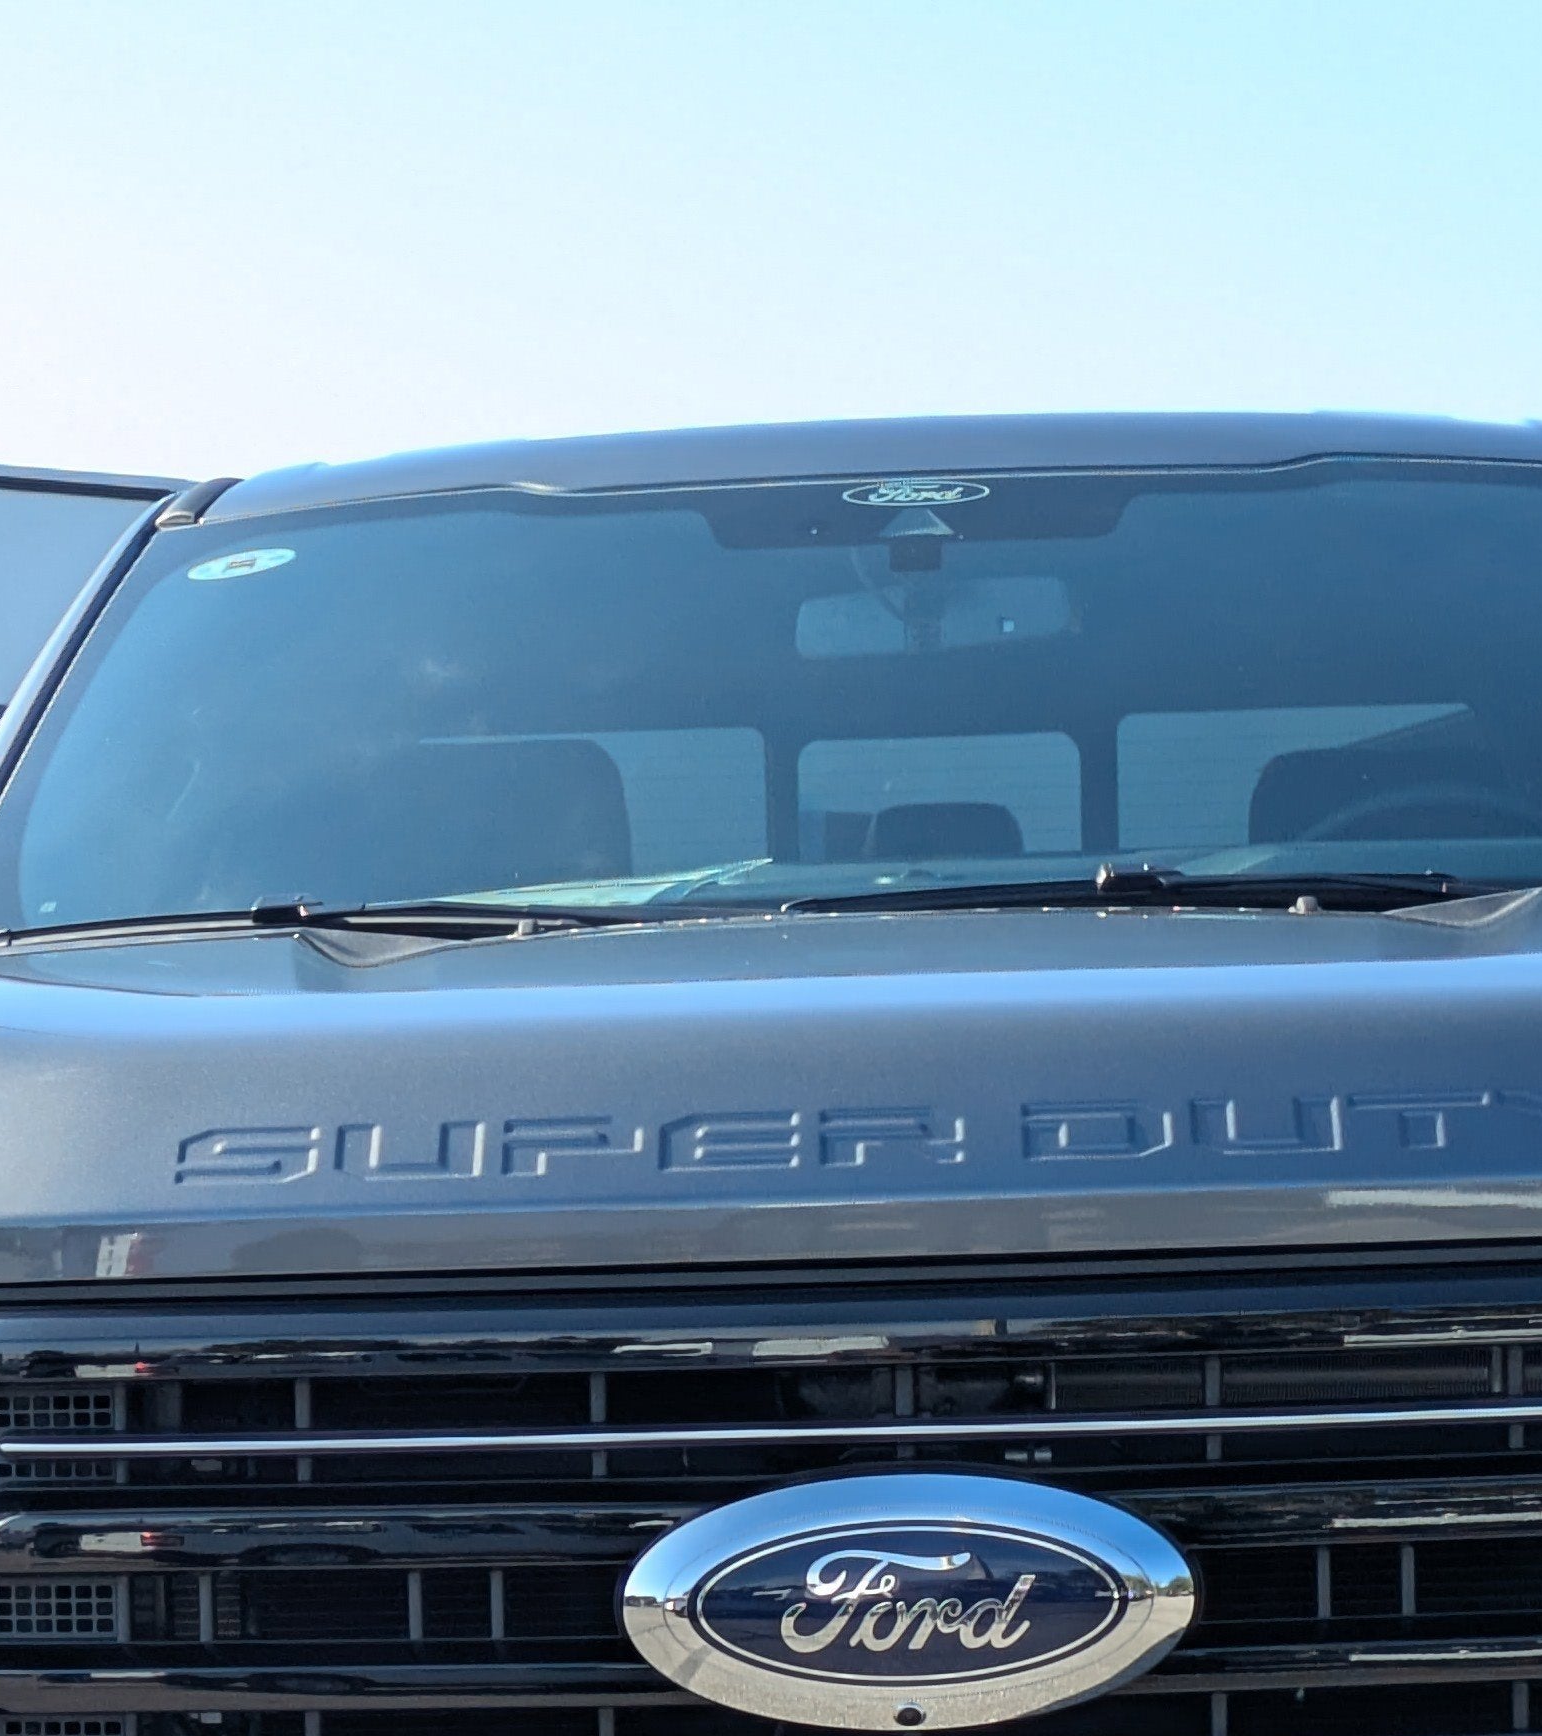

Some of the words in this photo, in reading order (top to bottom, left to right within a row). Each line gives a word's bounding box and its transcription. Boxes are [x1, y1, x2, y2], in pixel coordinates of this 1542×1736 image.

[868, 483, 963, 502] Ford
[174, 1105, 964, 1184] SUPER
[780, 1549, 1036, 1654] Ford
